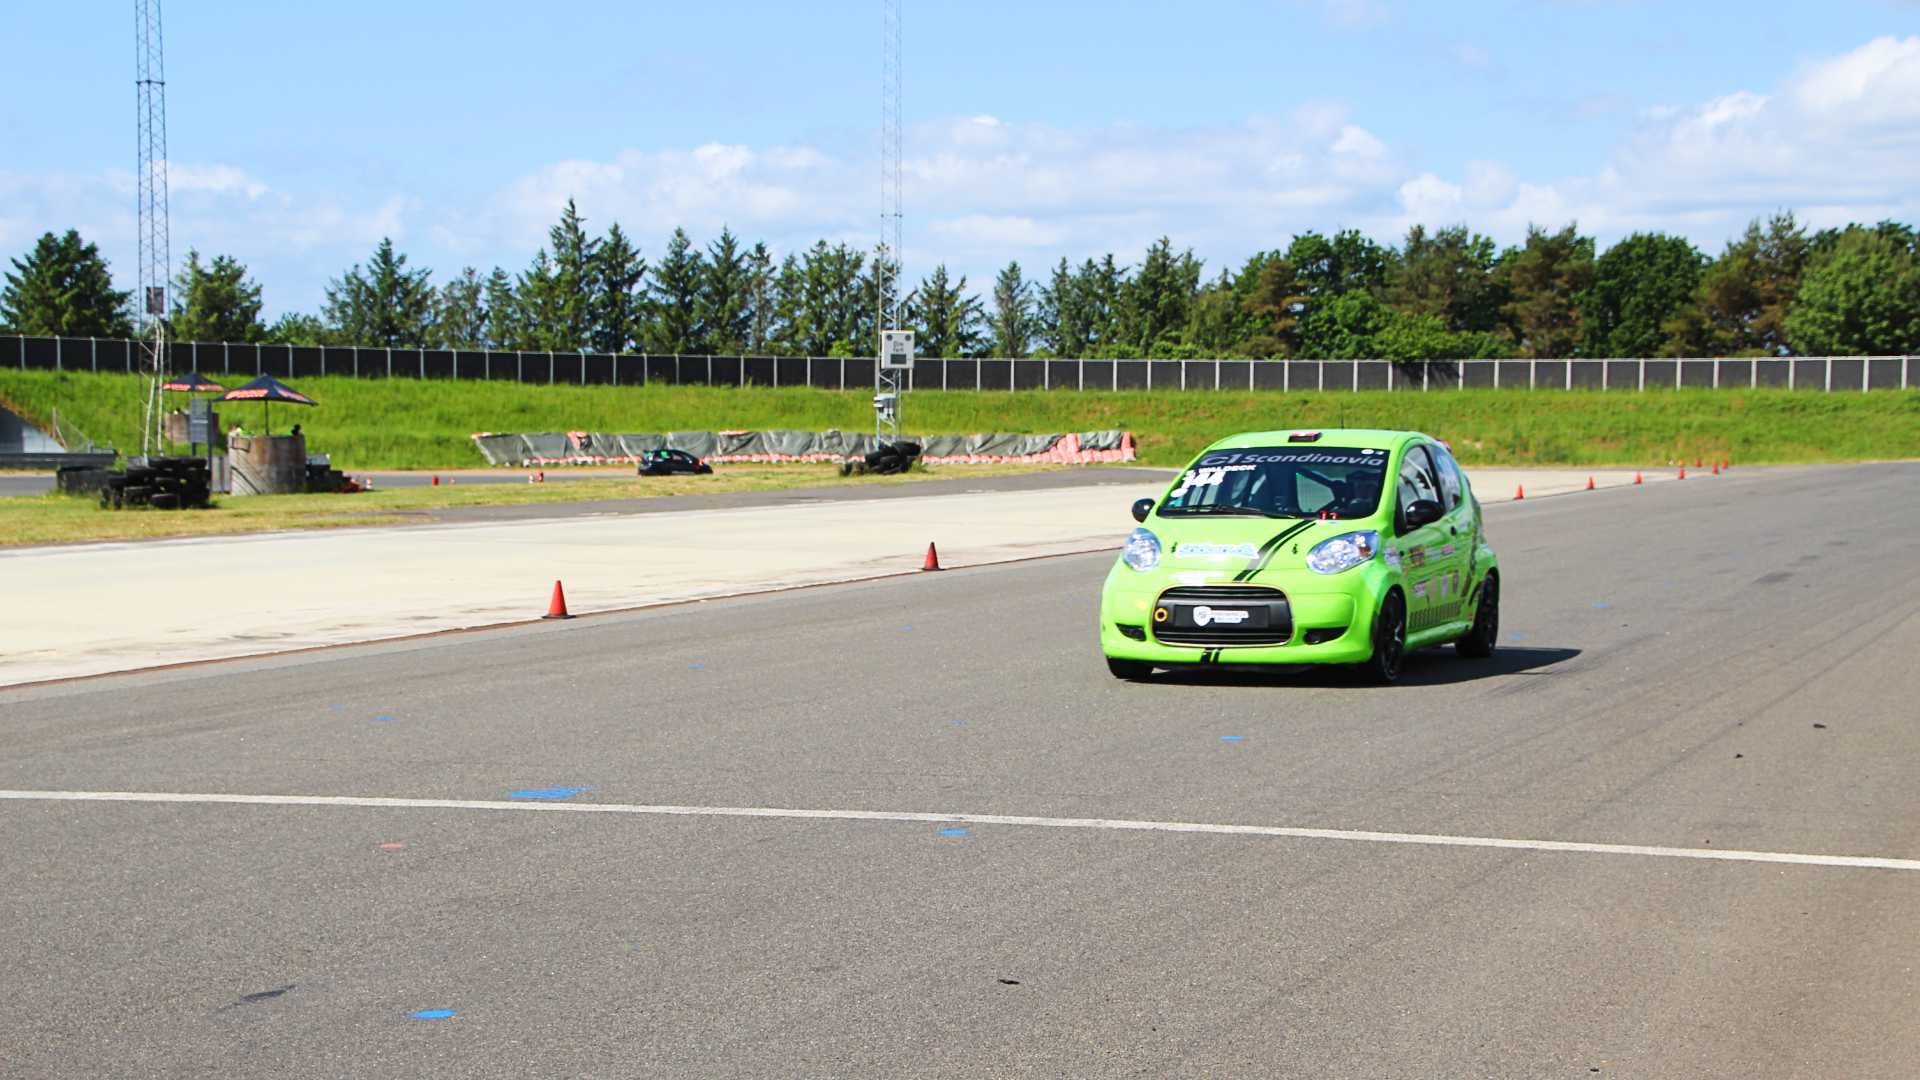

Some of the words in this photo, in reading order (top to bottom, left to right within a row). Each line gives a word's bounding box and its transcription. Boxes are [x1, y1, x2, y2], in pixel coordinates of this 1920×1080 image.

[1241, 452, 1385, 466] Scandinavia
[1198, 464, 1257, 474] WALDECK
[1182, 472, 1225, 488] 144
